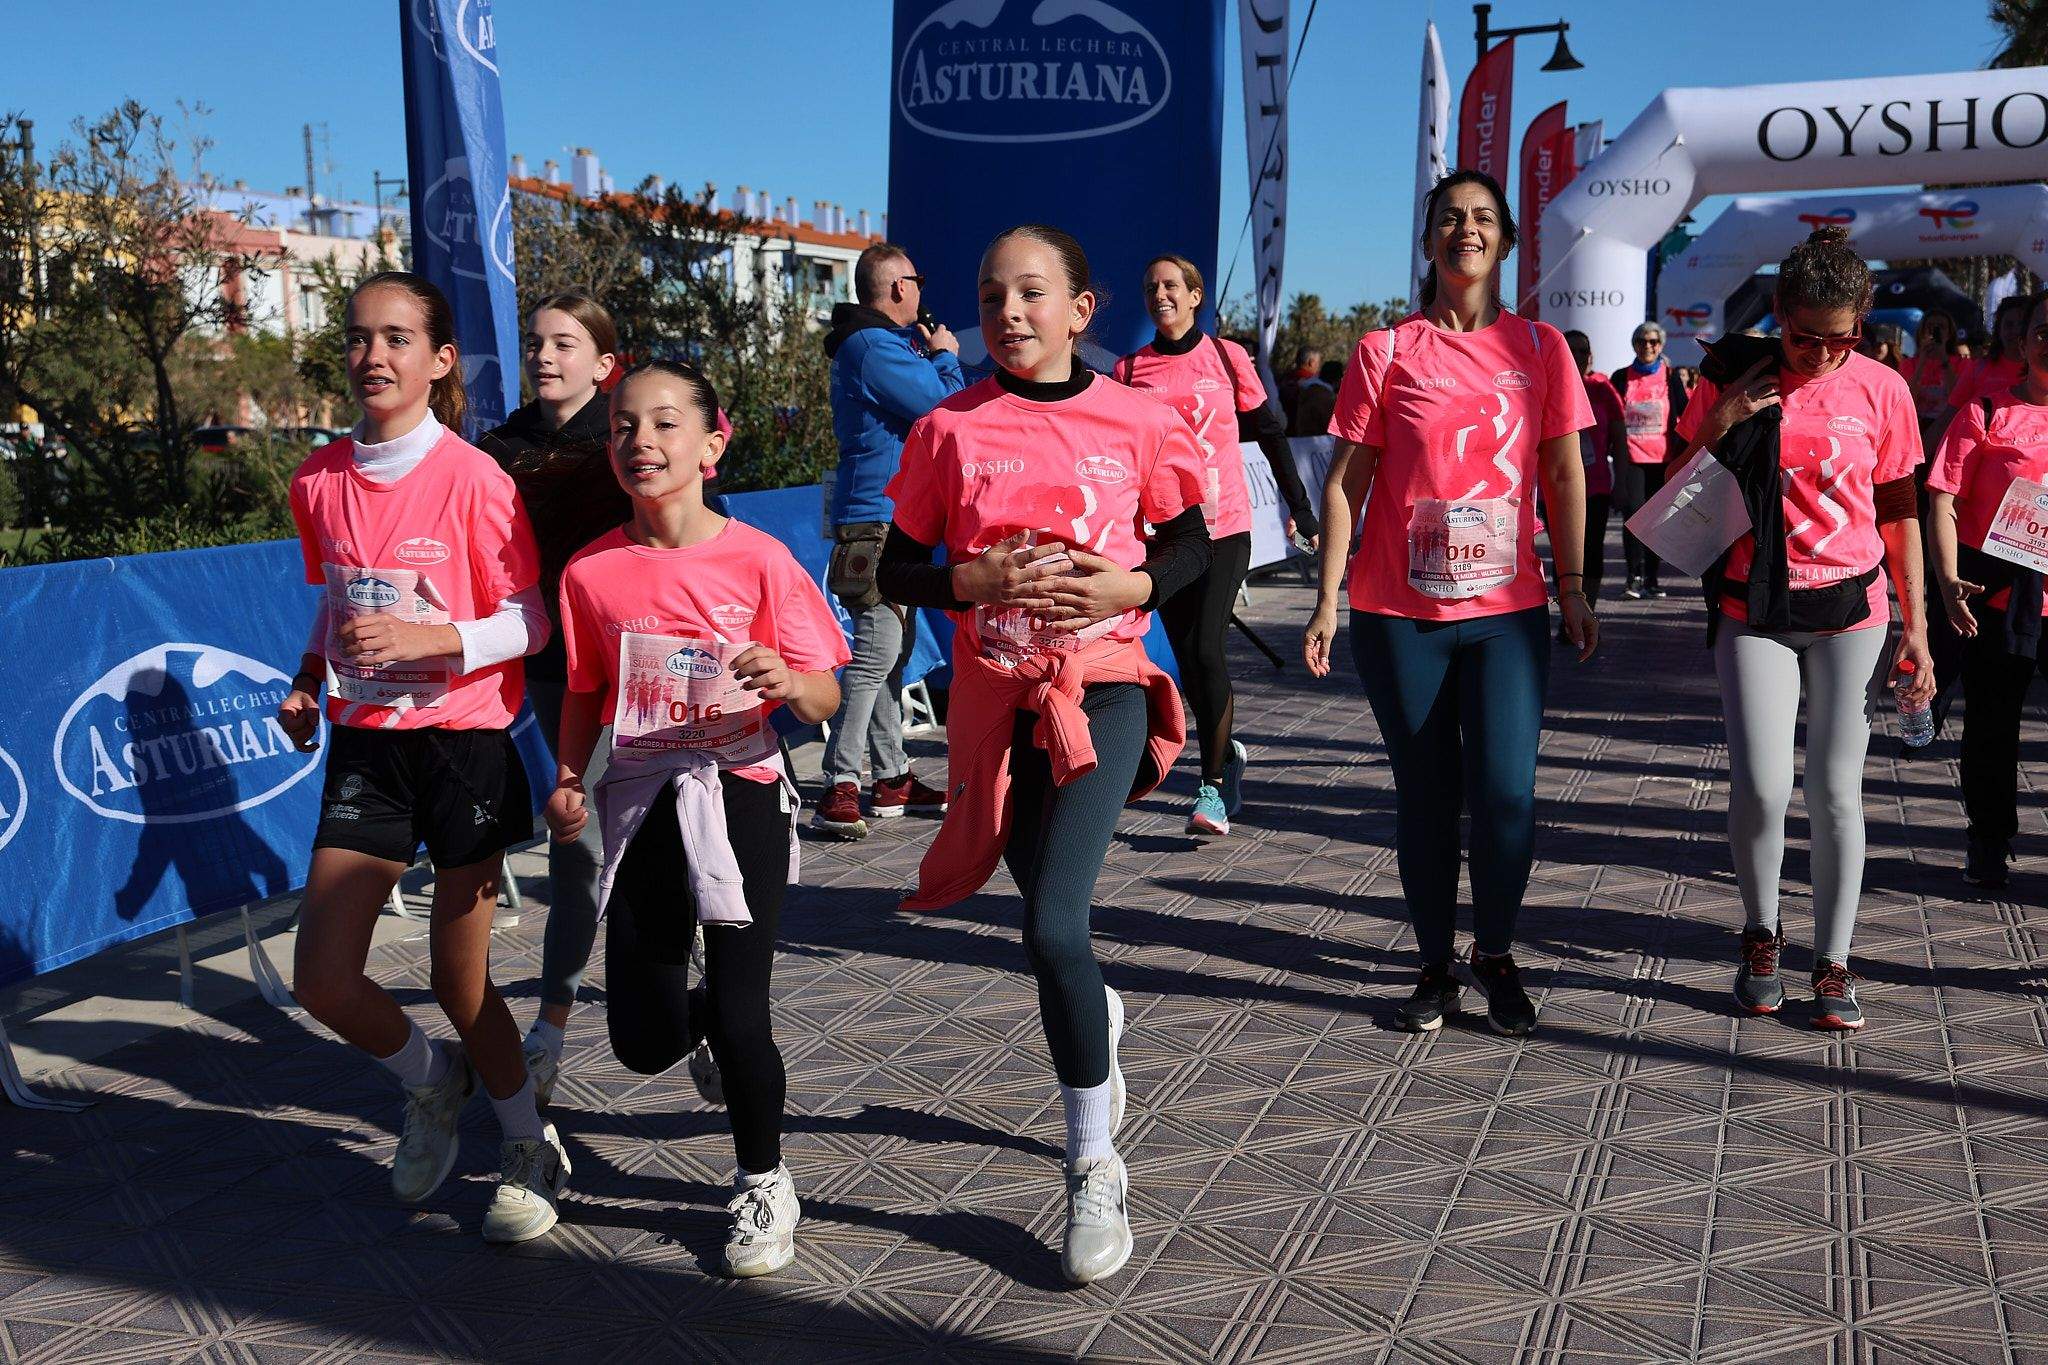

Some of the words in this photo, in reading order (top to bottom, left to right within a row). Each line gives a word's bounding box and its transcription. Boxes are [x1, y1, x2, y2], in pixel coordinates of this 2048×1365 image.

[938, 38, 1030, 57] CENTRAL
[1041, 38, 1144, 58] LECHERA
[907, 48, 1152, 108] ASTURIANA
[1475, 91, 1497, 175] ander
[1757, 92, 2048, 162] OYSHO
[1588, 178, 1671, 198] OYSHO
[1549, 290, 1625, 309] OYSHO
[1410, 377, 1457, 390] OYSHO
[961, 459, 1025, 478] OYSHO
[1081, 463, 1125, 479] ASTURIANA
[1445, 515, 1484, 524] ASTURIANA
[2028, 538, 2046, 548] 3193
[398, 547, 447, 559] ASTURIANA
[1445, 543, 1486, 561] 016
[1993, 544, 2024, 560] OYSHO
[1453, 563, 1472, 572] 3189
[1806, 567, 1820, 581] LA
[1822, 566, 1861, 581] MUJER
[349, 587, 396, 602] ASTURIANA
[1419, 583, 1454, 593] OYSHO
[1039, 637, 1066, 650] 3212
[670, 659, 719, 675] ASTURIANA
[385, 689, 431, 699] Santander
[114, 704, 205, 732] CENTRAL
[207, 689, 289, 716] LECHERA
[669, 701, 723, 725] 016
[679, 729, 706, 740] 3220
[633, 739, 664, 749] CARRERA
[667, 741, 676, 749] DE
[688, 740, 713, 749] MUJER
[726, 744, 750, 757] ander
[90, 715, 297, 797] ASTURIAN
